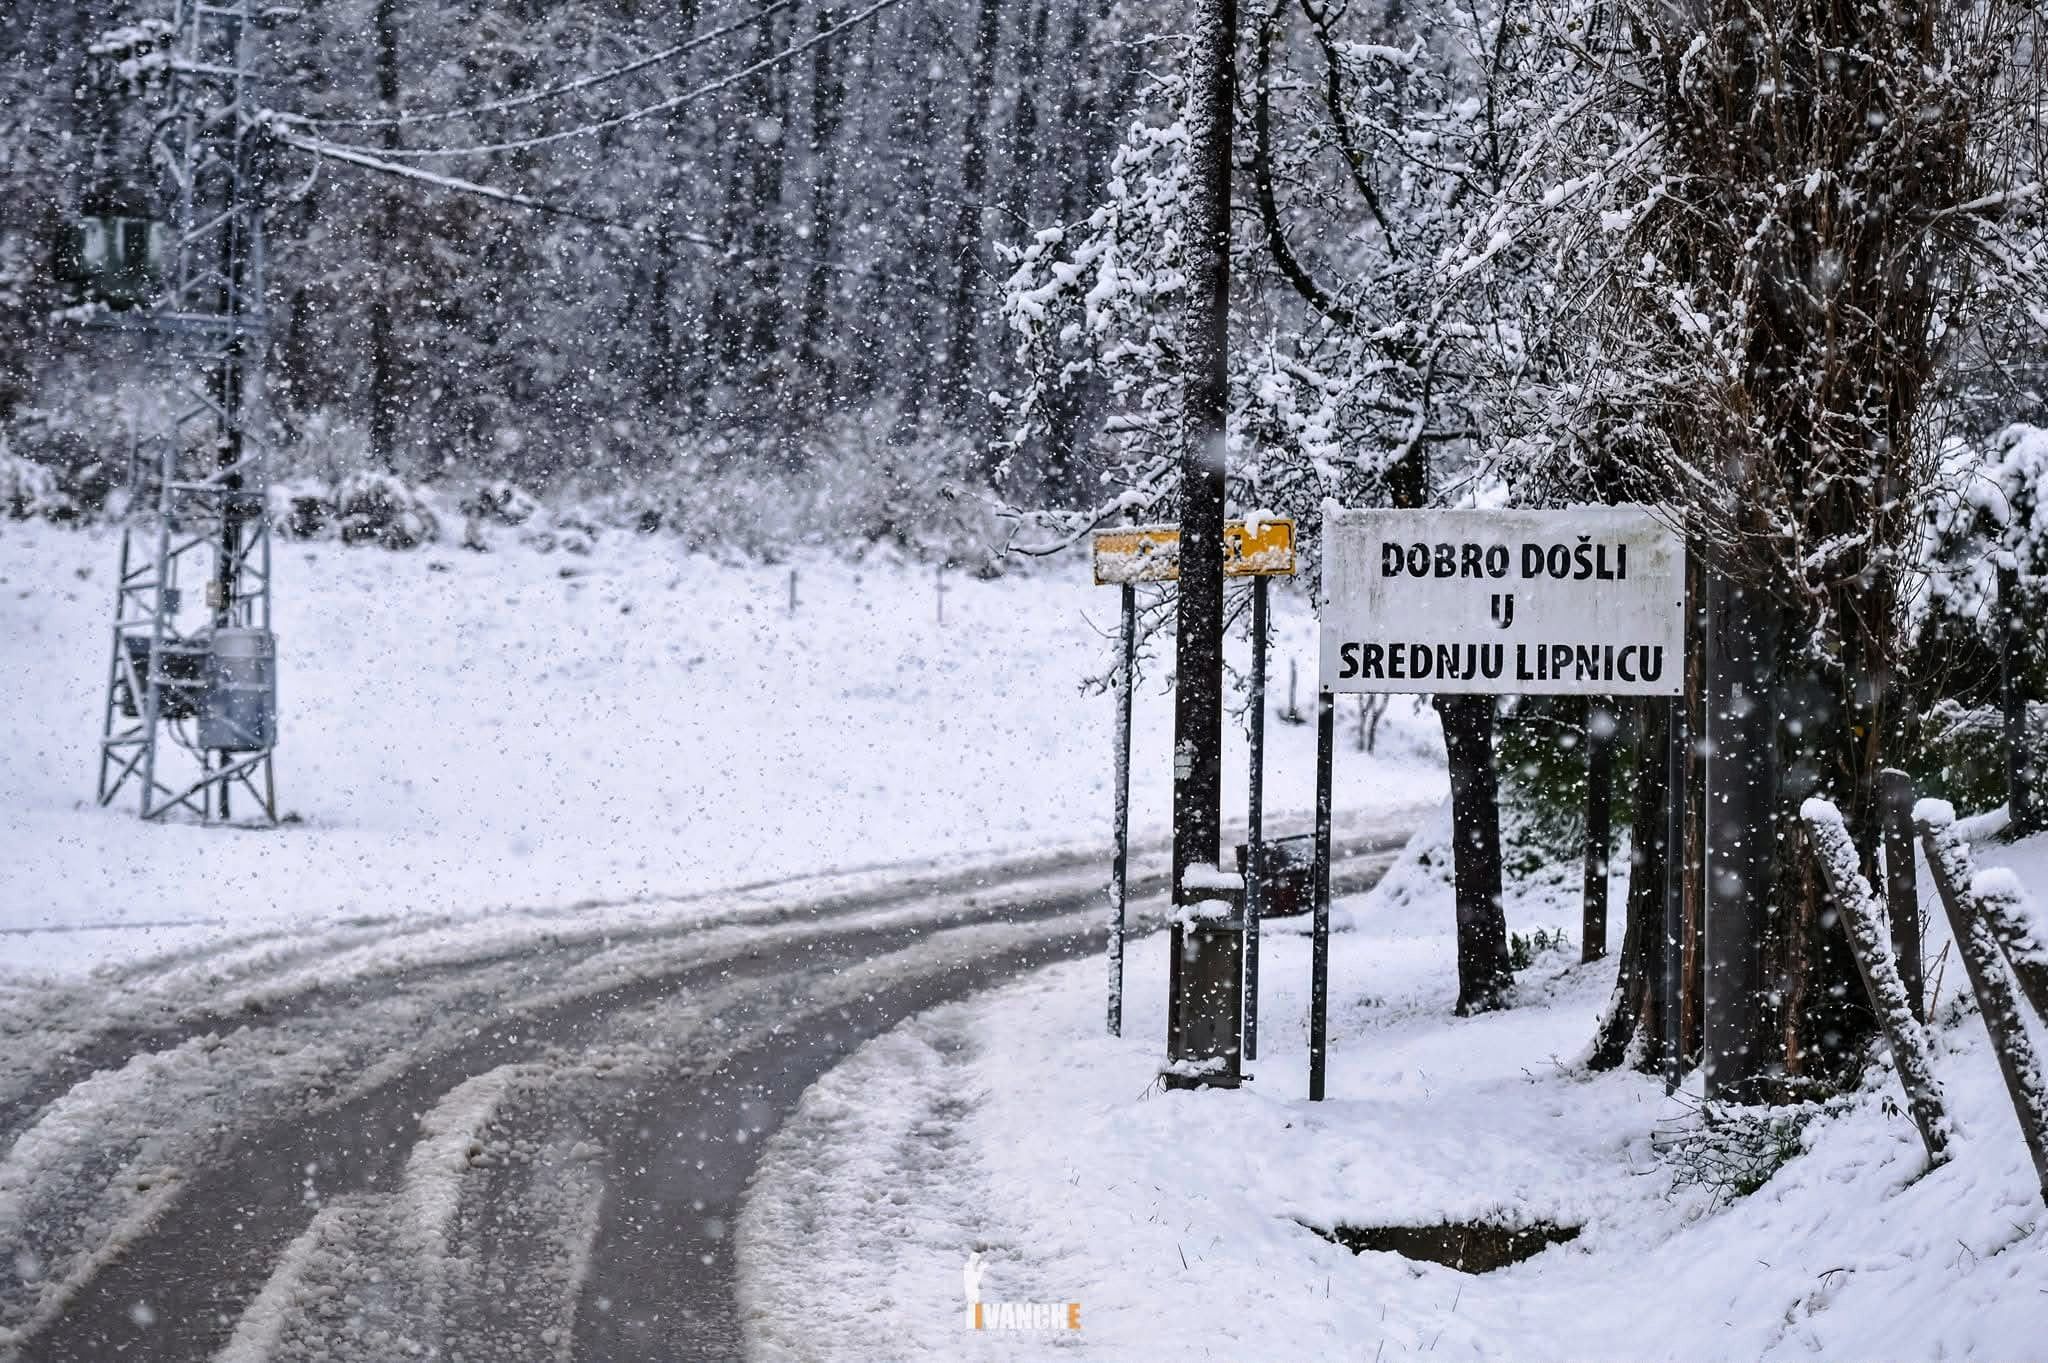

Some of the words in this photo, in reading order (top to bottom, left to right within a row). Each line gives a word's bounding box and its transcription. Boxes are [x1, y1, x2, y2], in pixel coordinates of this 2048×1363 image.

[1381, 542, 1510, 579] DOBRO
[1521, 535, 1627, 580] DOŠLI
[1491, 593, 1514, 629] U
[1339, 642, 1504, 680] SREDNJU
[1516, 644, 1663, 682] LIPNICU
